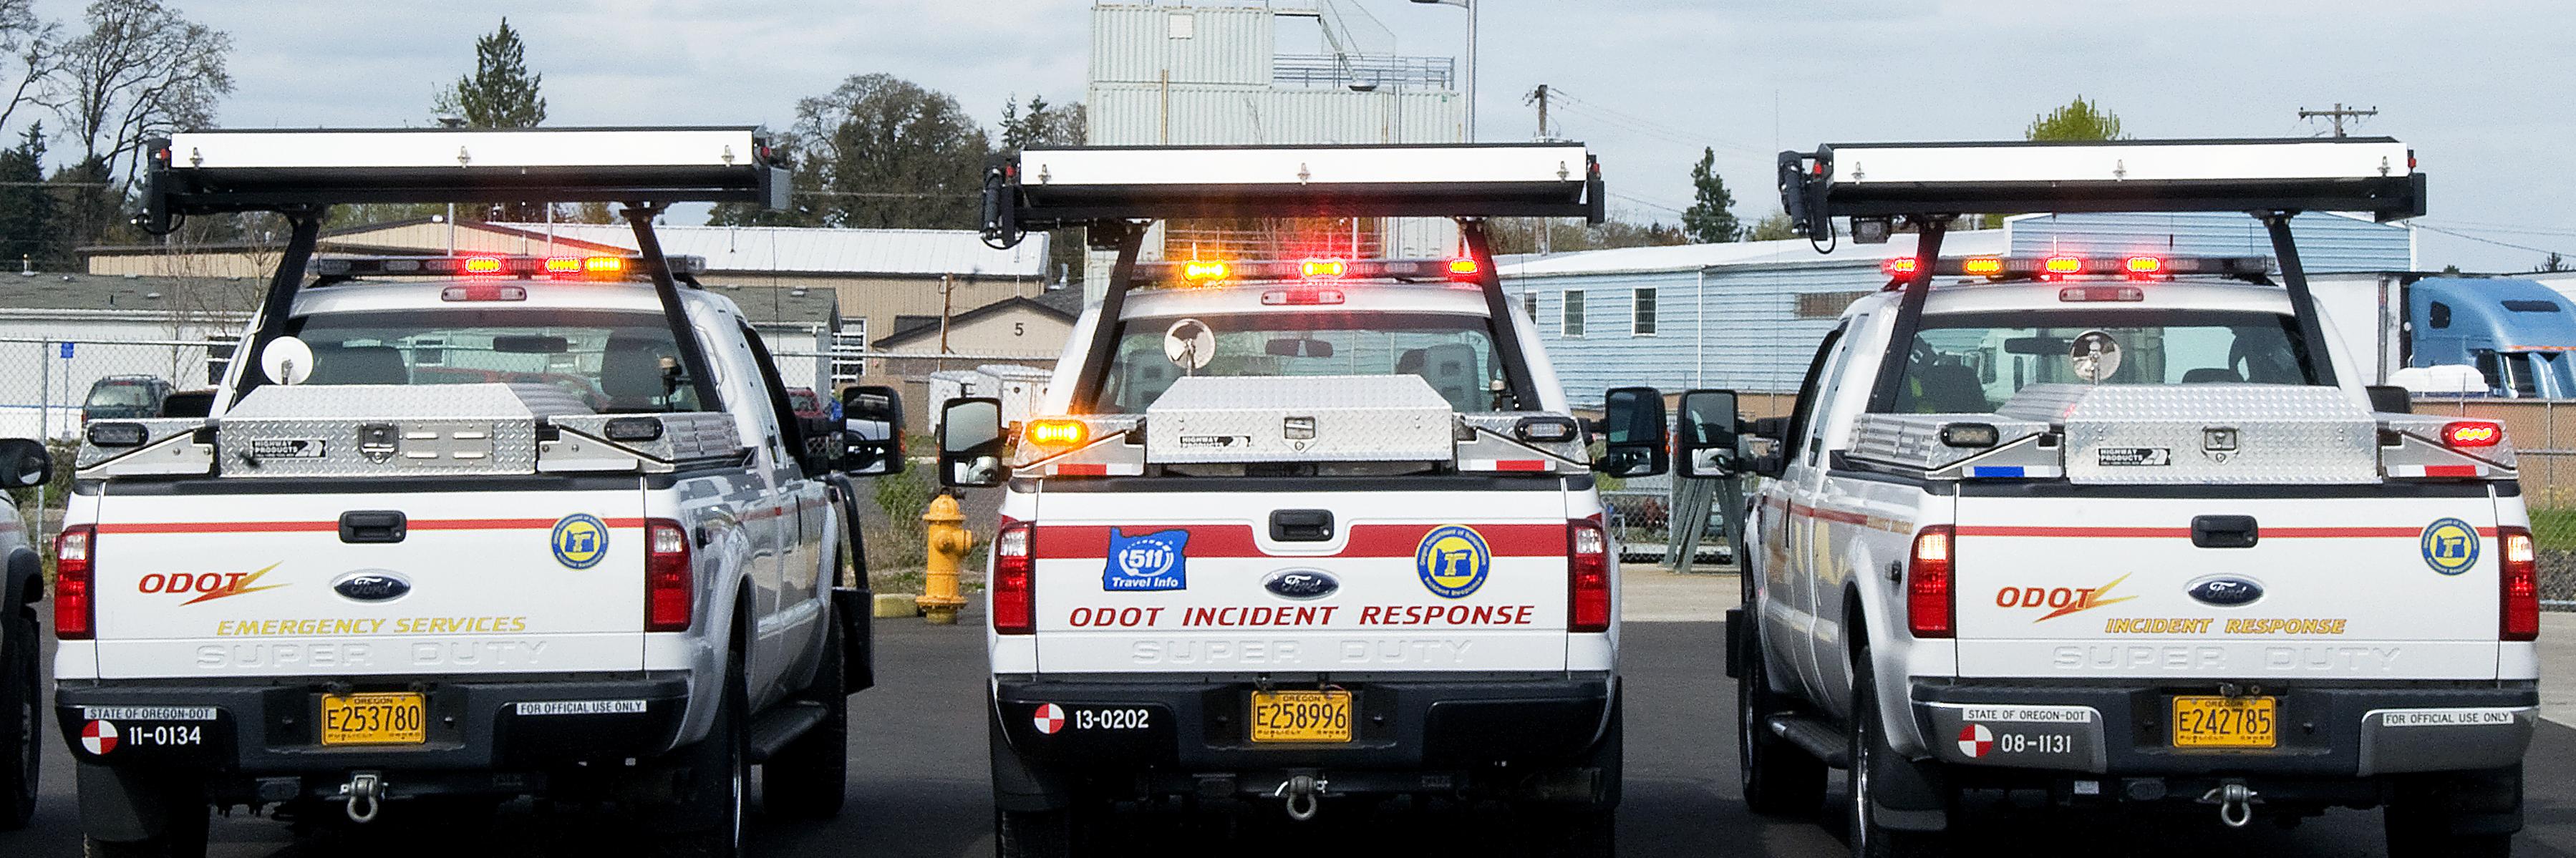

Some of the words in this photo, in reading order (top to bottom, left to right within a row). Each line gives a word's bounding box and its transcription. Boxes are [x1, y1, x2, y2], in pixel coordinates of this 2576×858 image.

[1015, 323, 1024, 336] 5
[1128, 549, 1163, 567] 511
[138, 572, 248, 593] ODOT
[1112, 577, 1151, 588] Travel
[1153, 576, 1179, 588] Info
[1995, 586, 2096, 608] ODOT
[217, 618, 387, 636] EMERGENCY
[394, 616, 527, 633] SERVICES
[1069, 607, 1165, 628] ODOT
[1182, 606, 1340, 627] INCIDENT
[1359, 605, 1536, 625] RESPONSE
[2104, 618, 2214, 634] INCIDENT
[2224, 618, 2348, 635] RESPONSE
[197, 642, 373, 668] SUPER
[411, 640, 548, 666] DUTY
[1132, 640, 1302, 666] SUPER
[1339, 639, 1473, 664] DUTY
[2053, 645, 2225, 671] SUPER
[2265, 646, 2401, 671] DUTY
[90, 708, 122, 718] STATE
[125, 708, 139, 718] OF
[142, 708, 210, 718] OREGON-DOT
[520, 704, 541, 714] FOR
[544, 703, 589, 713] OFFICIAL
[592, 702, 611, 712] USE
[615, 701, 642, 712] ONLY
[1256, 703, 1347, 729] E258996
[1968, 709, 1998, 719] STATE
[2002, 710, 2015, 720] OF
[2019, 710, 2086, 721] OREGON-DOT
[327, 706, 420, 732] E253780
[1075, 709, 1149, 729] 13-0202
[2179, 708, 2271, 735] E242785
[2386, 714, 2406, 724] FOR
[2410, 713, 2454, 723] OFFICIAL
[2459, 713, 2479, 723] USE
[2484, 712, 2509, 723] ONLY
[129, 726, 201, 746] 11-0134
[2001, 733, 2071, 754] 08-1131
